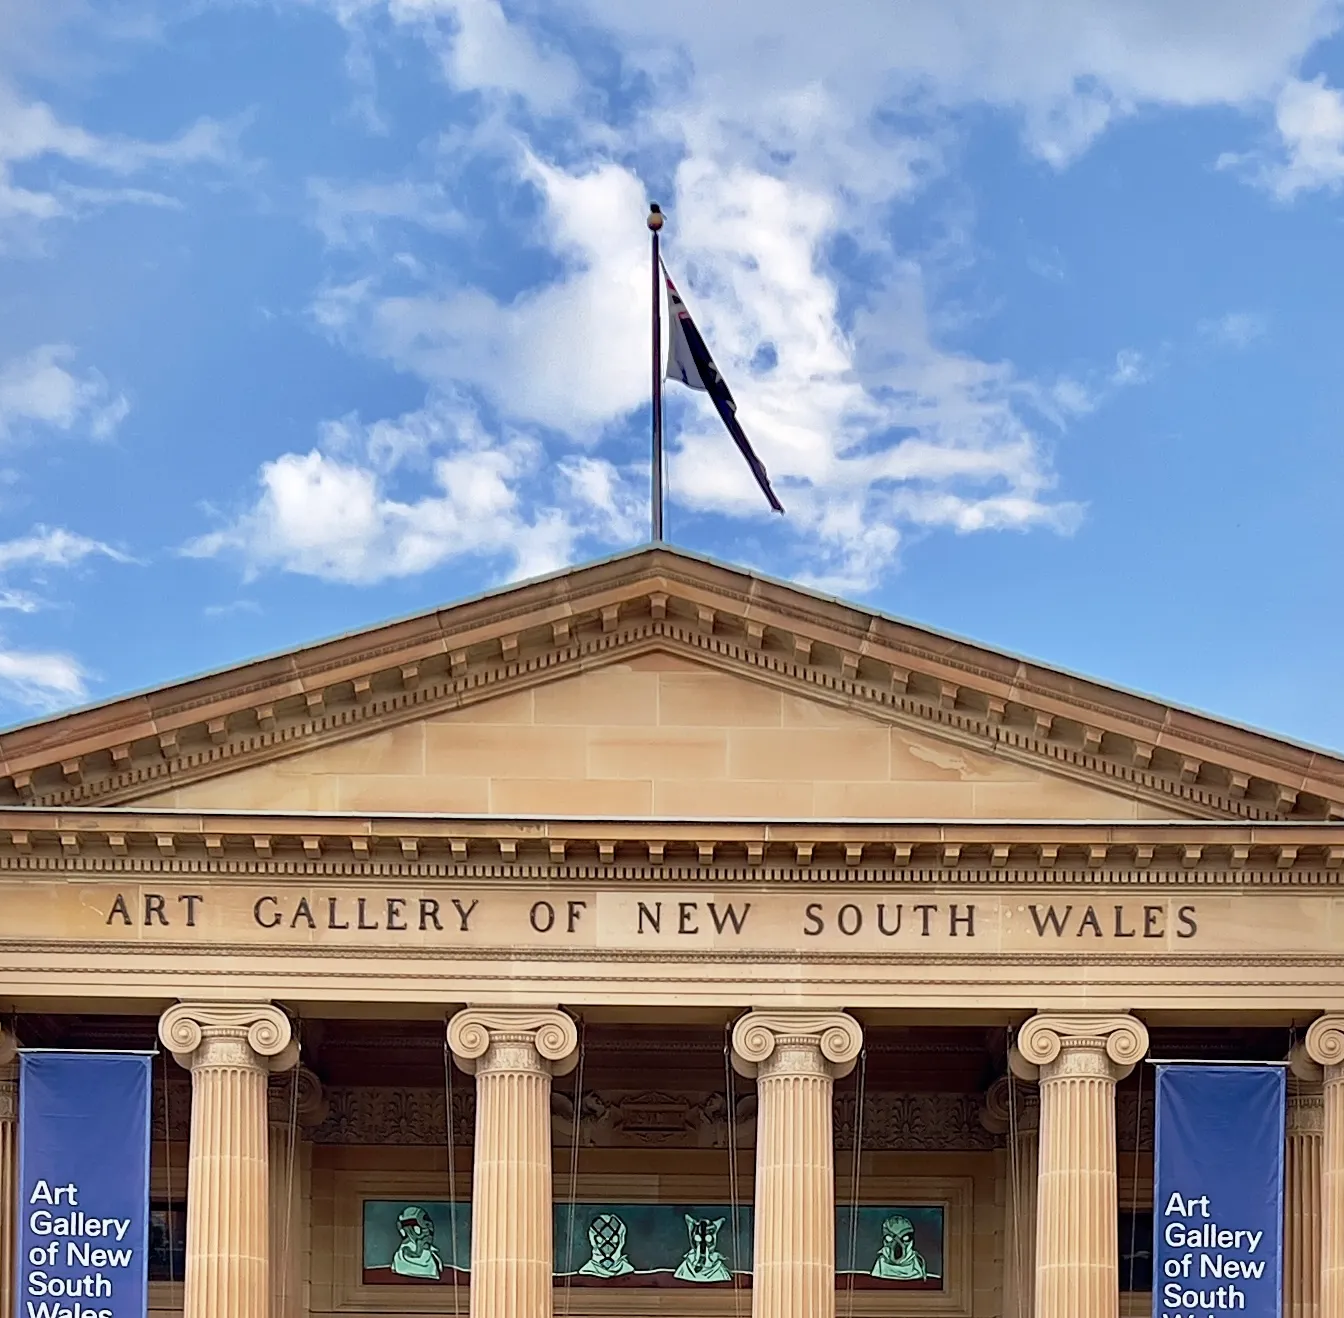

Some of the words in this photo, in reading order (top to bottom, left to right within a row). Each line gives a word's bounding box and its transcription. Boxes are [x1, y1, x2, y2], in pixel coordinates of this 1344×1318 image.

[105, 893, 204, 927] ART
[253, 897, 478, 932] GALLERY
[529, 900, 587, 933] OF
[637, 901, 752, 935] NEW
[803, 903, 976, 937] SOUTH
[1031, 905, 1198, 939] WALES
[29, 1180, 78, 1206] Art
[1164, 1192, 1211, 1218] Art
[29, 1210, 131, 1241] Gallery
[1165, 1222, 1263, 1253] Gallery
[29, 1241, 60, 1266] of
[67, 1242, 133, 1267] New
[1164, 1253, 1193, 1278] of
[1200, 1253, 1266, 1279] New
[28, 1271, 112, 1297] South
[1163, 1283, 1245, 1309] South
